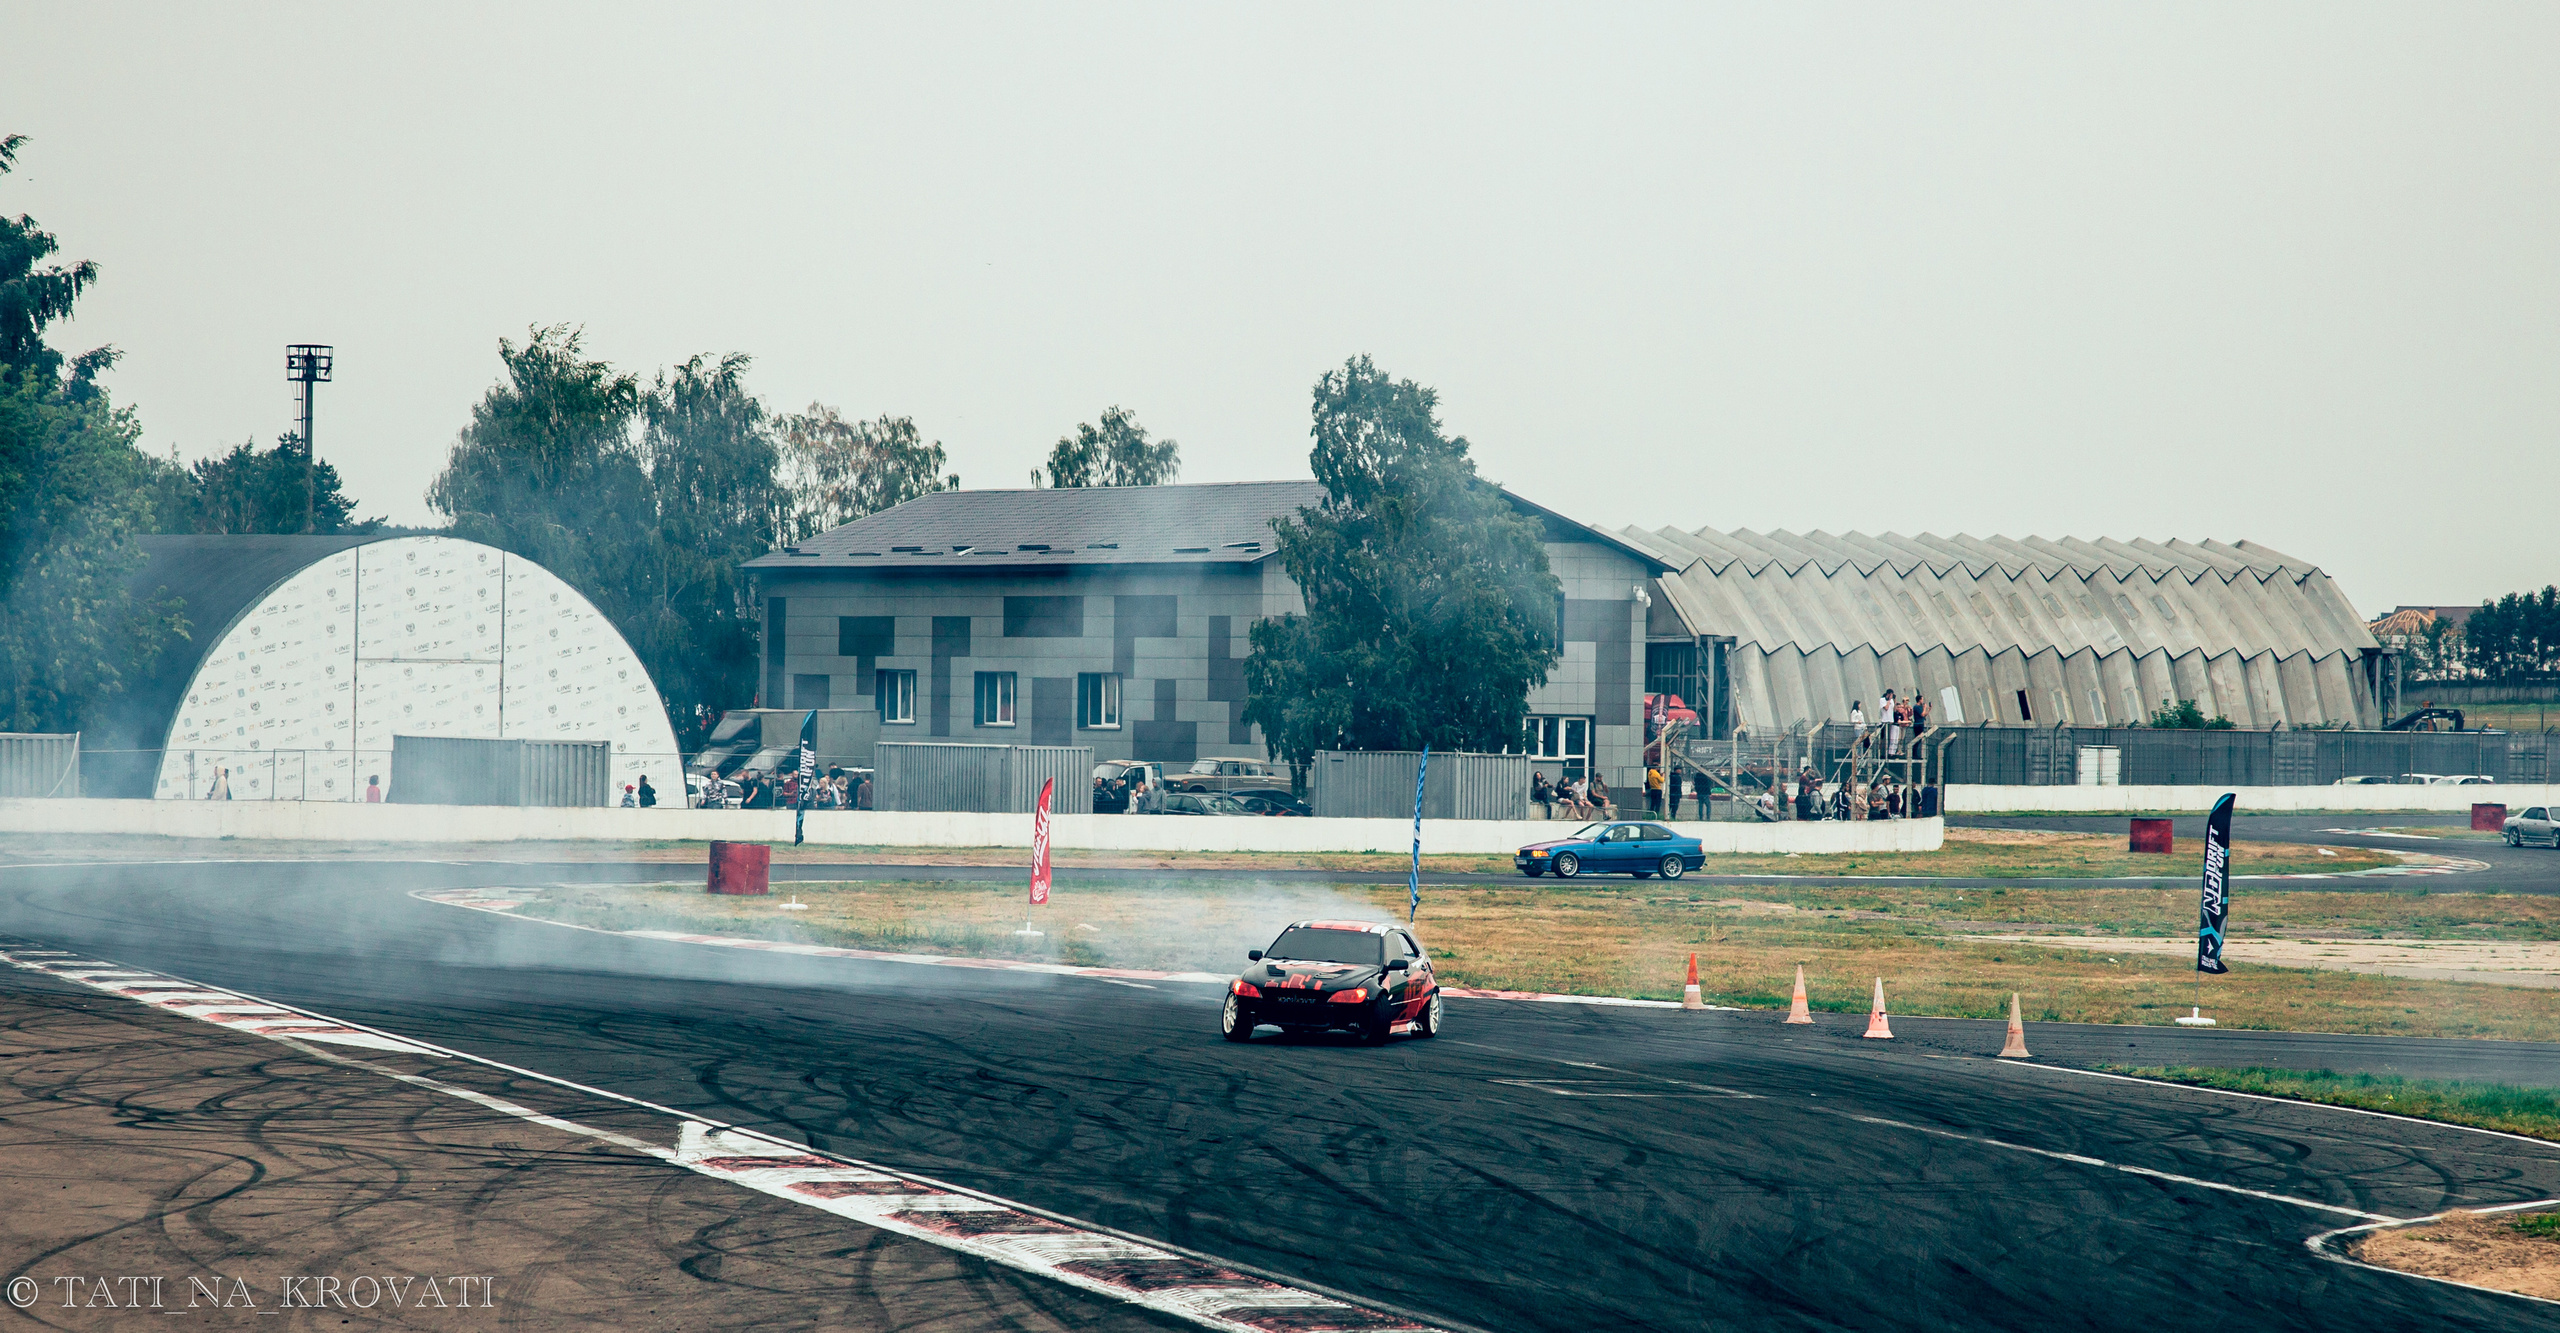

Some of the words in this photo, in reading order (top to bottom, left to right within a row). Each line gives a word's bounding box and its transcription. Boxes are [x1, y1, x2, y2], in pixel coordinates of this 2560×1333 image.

[414, 565, 430, 575] LINE
[485, 567, 501, 576] LINE
[262, 605, 278, 614] LINE
[414, 601, 430, 611] LINE
[485, 602, 501, 612] LINE
[260, 643, 276, 652] LINE
[334, 643, 350, 653] LINE
[413, 642, 429, 652] LINE
[484, 643, 500, 653] LINE
[556, 647, 573, 657] LINE
[259, 680, 275, 689] LINE
[333, 680, 350, 690] LINE
[556, 683, 572, 693] LINE
[631, 683, 647, 692] LINE
[259, 718, 275, 728] LINE
[333, 718, 349, 728] LINE
[555, 721, 571, 730] LINE
[625, 721, 641, 731] LINE
[183, 731, 199, 741] LINE
[2206, 824, 2219, 872] DRIFT
[2214, 843, 2225, 877] FUN
